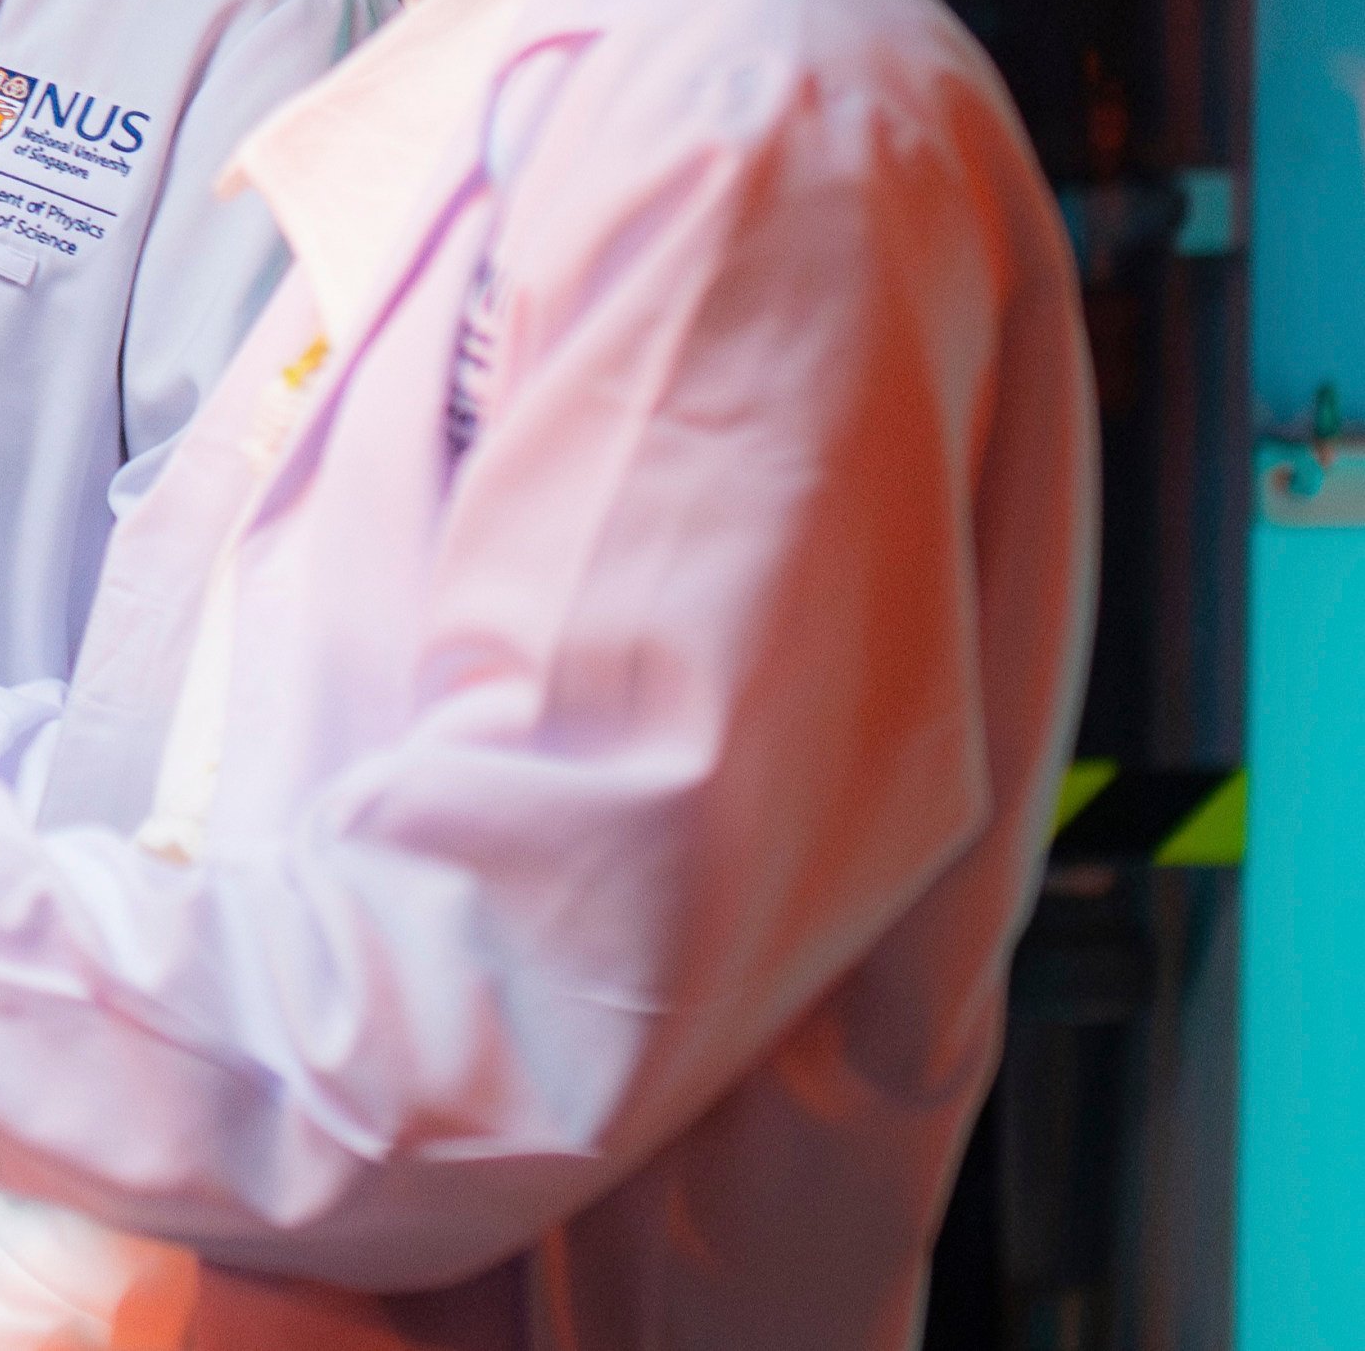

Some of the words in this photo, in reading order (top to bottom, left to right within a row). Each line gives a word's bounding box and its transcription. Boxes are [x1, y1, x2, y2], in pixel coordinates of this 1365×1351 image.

[32, 82, 151, 153] NUS
[14, 145, 31, 156] of
[28, 147, 89, 180] Singapore
[23, 127, 73, 154] National
[74, 144, 132, 178] University
[14, 219, 78, 256] Science
[26, 201, 47, 216] of
[45, 204, 107, 240] Physics
